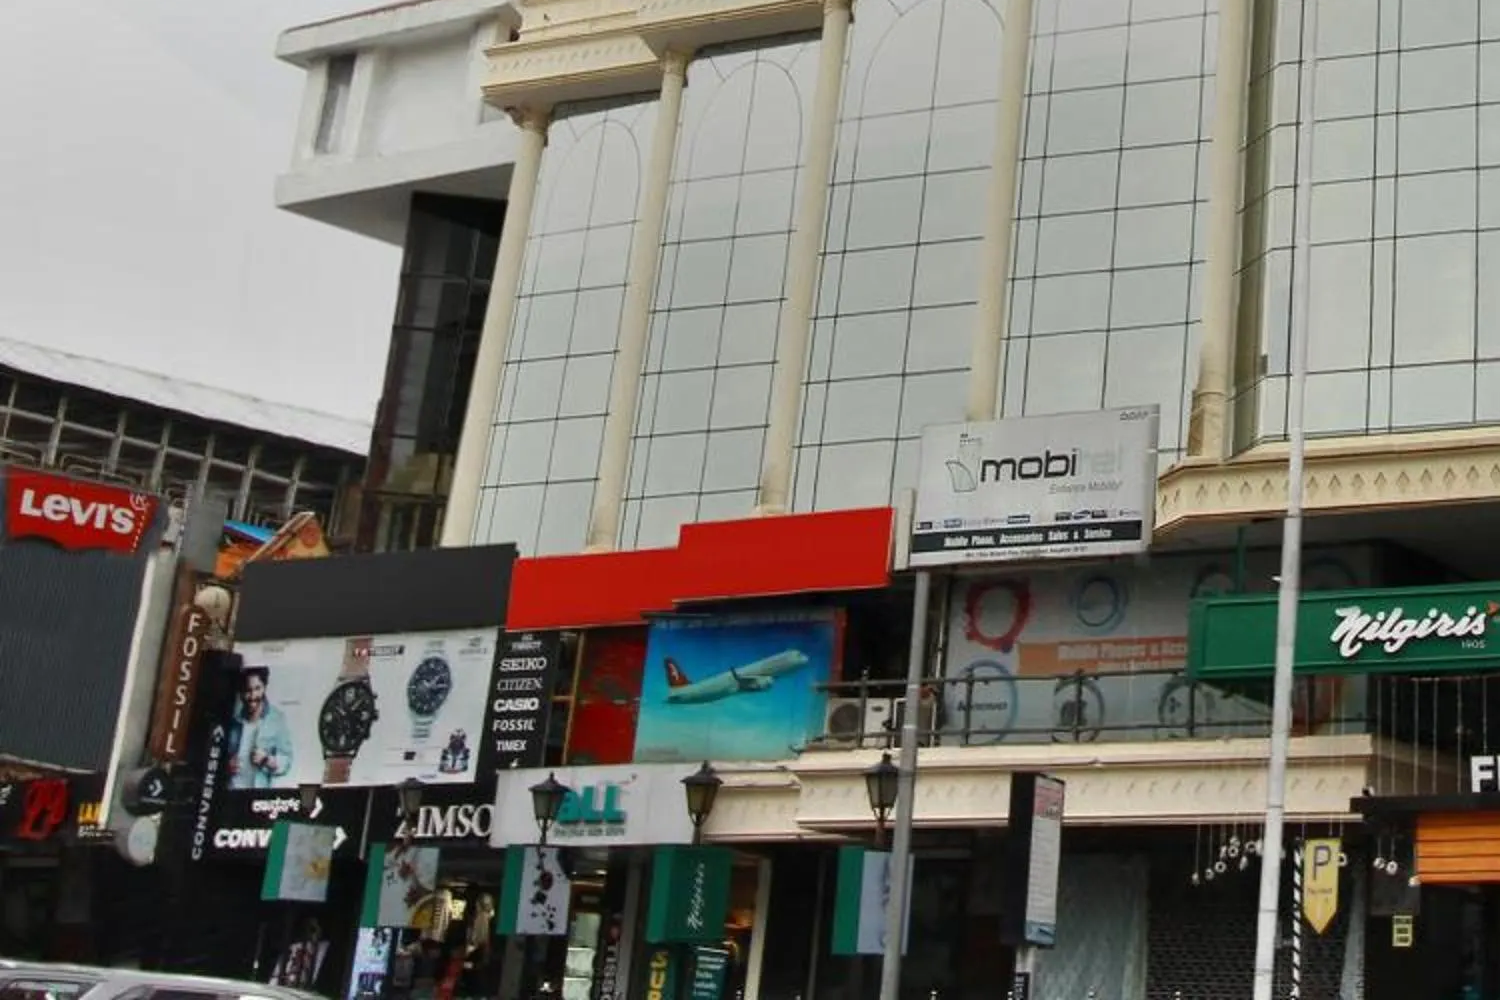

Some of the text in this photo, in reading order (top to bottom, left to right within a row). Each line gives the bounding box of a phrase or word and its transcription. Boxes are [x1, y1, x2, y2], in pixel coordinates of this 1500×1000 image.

[1330, 605, 1487, 658] Nilgiris
[499, 656, 547, 672] SEIKO
[166, 611, 202, 754] FOSSIL
[496, 677, 543, 691] CITIZEN
[493, 697, 540, 712] CASIO
[492, 718, 536, 732] FOSSIL
[496, 739, 528, 752] TIMEX
[1313, 845, 1332, 881] P
